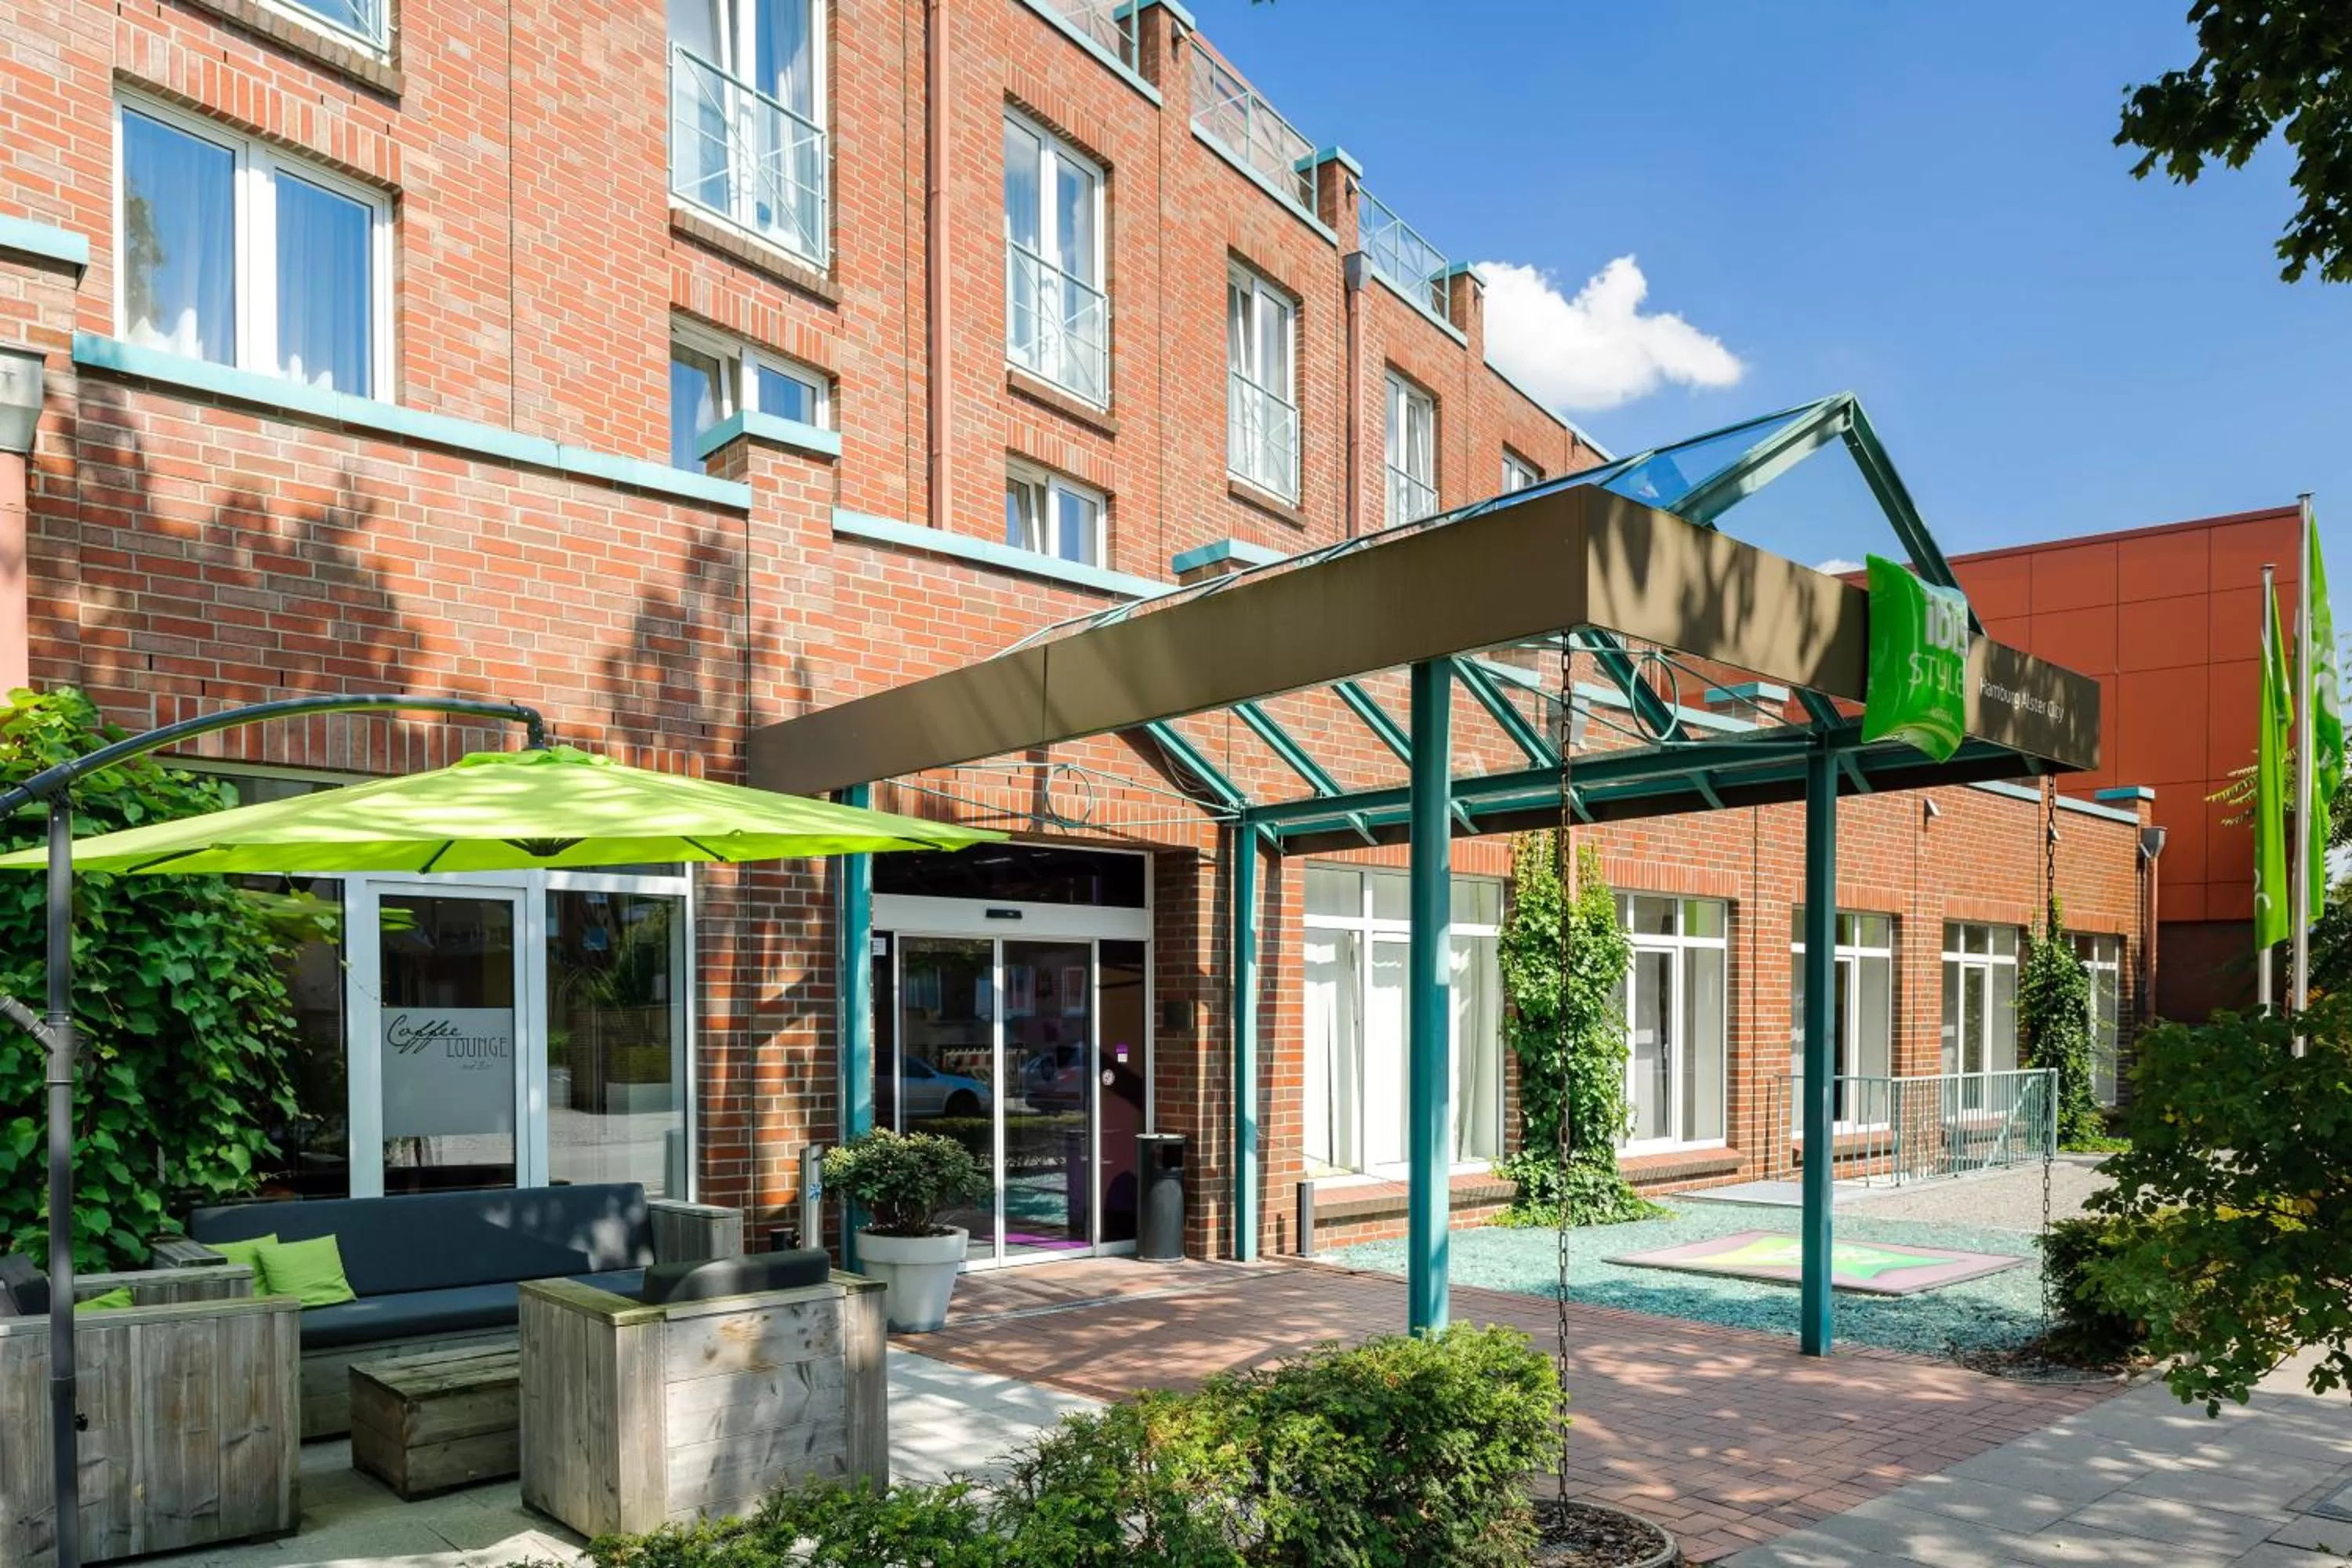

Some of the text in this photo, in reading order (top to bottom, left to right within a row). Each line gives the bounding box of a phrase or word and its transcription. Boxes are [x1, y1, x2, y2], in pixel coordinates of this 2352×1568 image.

[1980, 677, 2064, 724] Hamburg Alster City
[387, 1014, 462, 1054] Coffee
[445, 1036, 509, 1058] LOUNGE
